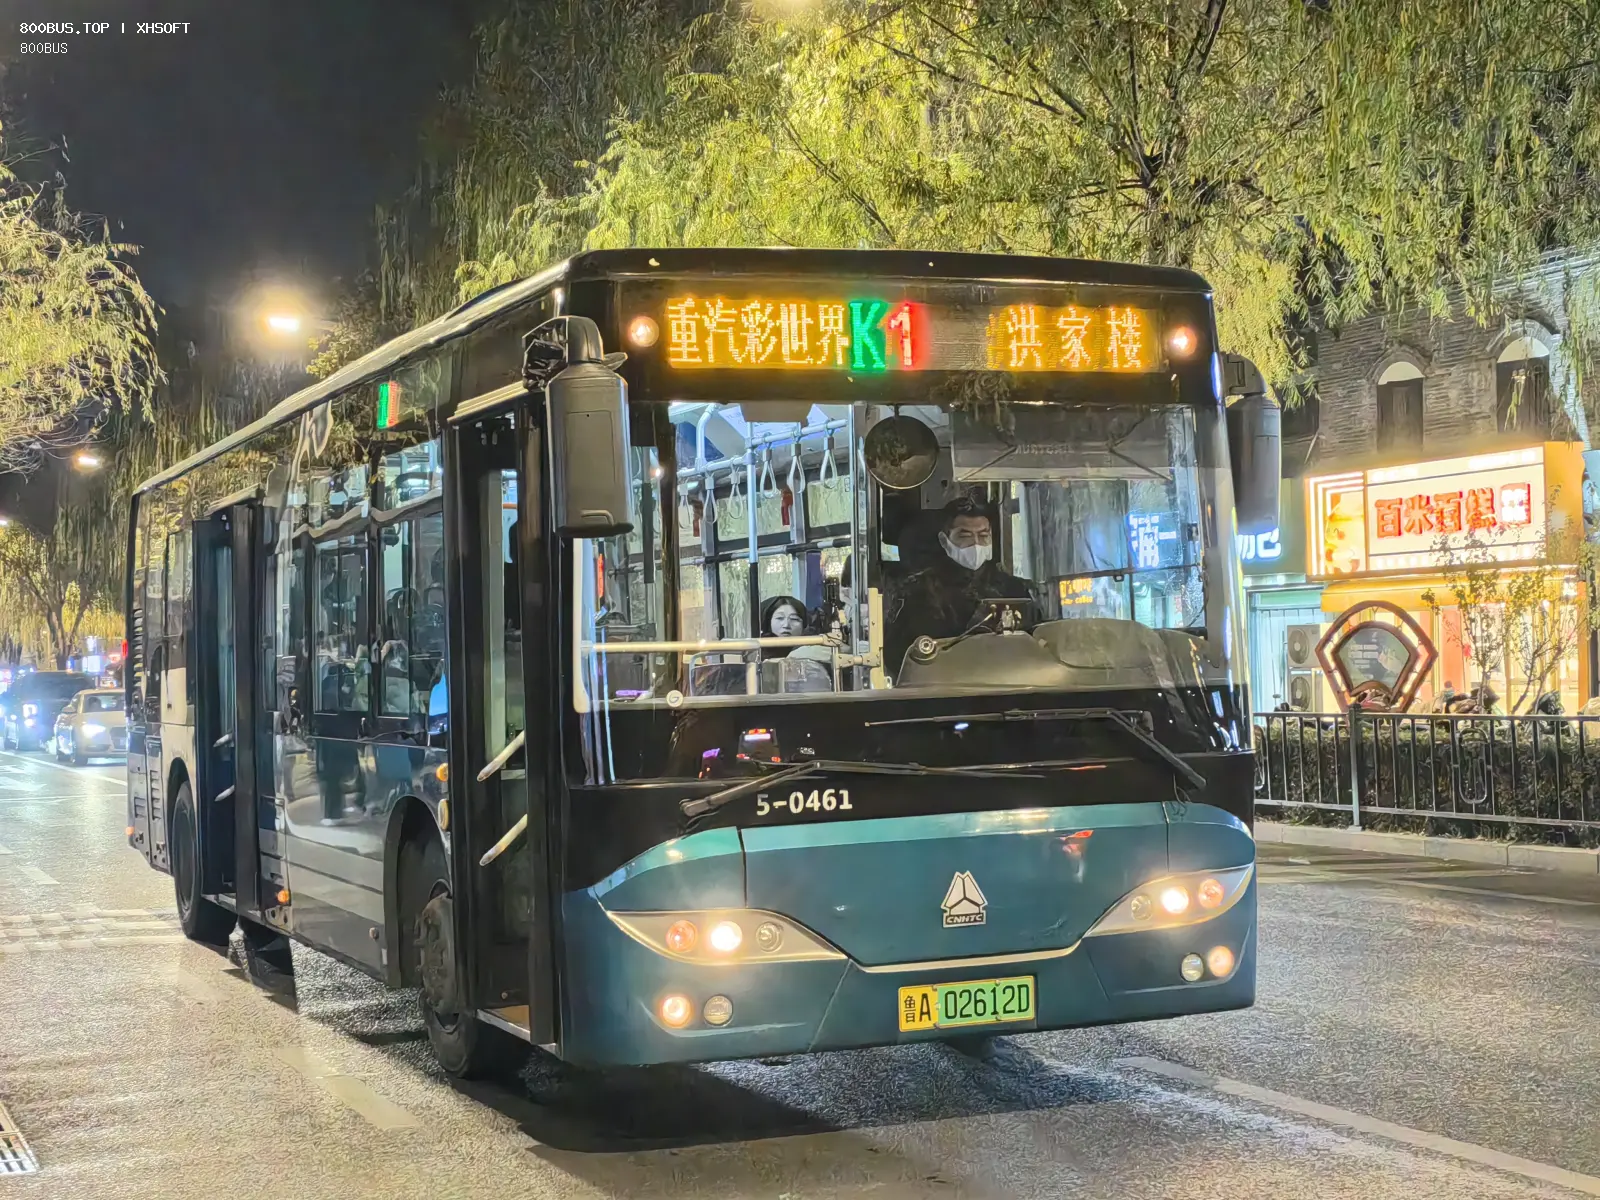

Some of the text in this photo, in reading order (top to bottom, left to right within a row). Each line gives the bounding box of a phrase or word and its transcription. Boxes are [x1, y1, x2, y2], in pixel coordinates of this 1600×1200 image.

[667, 298, 849, 365] 重汽彩世界
[849, 302, 913, 369] K1
[1005, 304, 1143, 369] 洪家楼
[756, 788, 853, 816] 5-0461
[946, 913, 983, 924] CNHTC
[944, 984, 1030, 1020] 02612D
